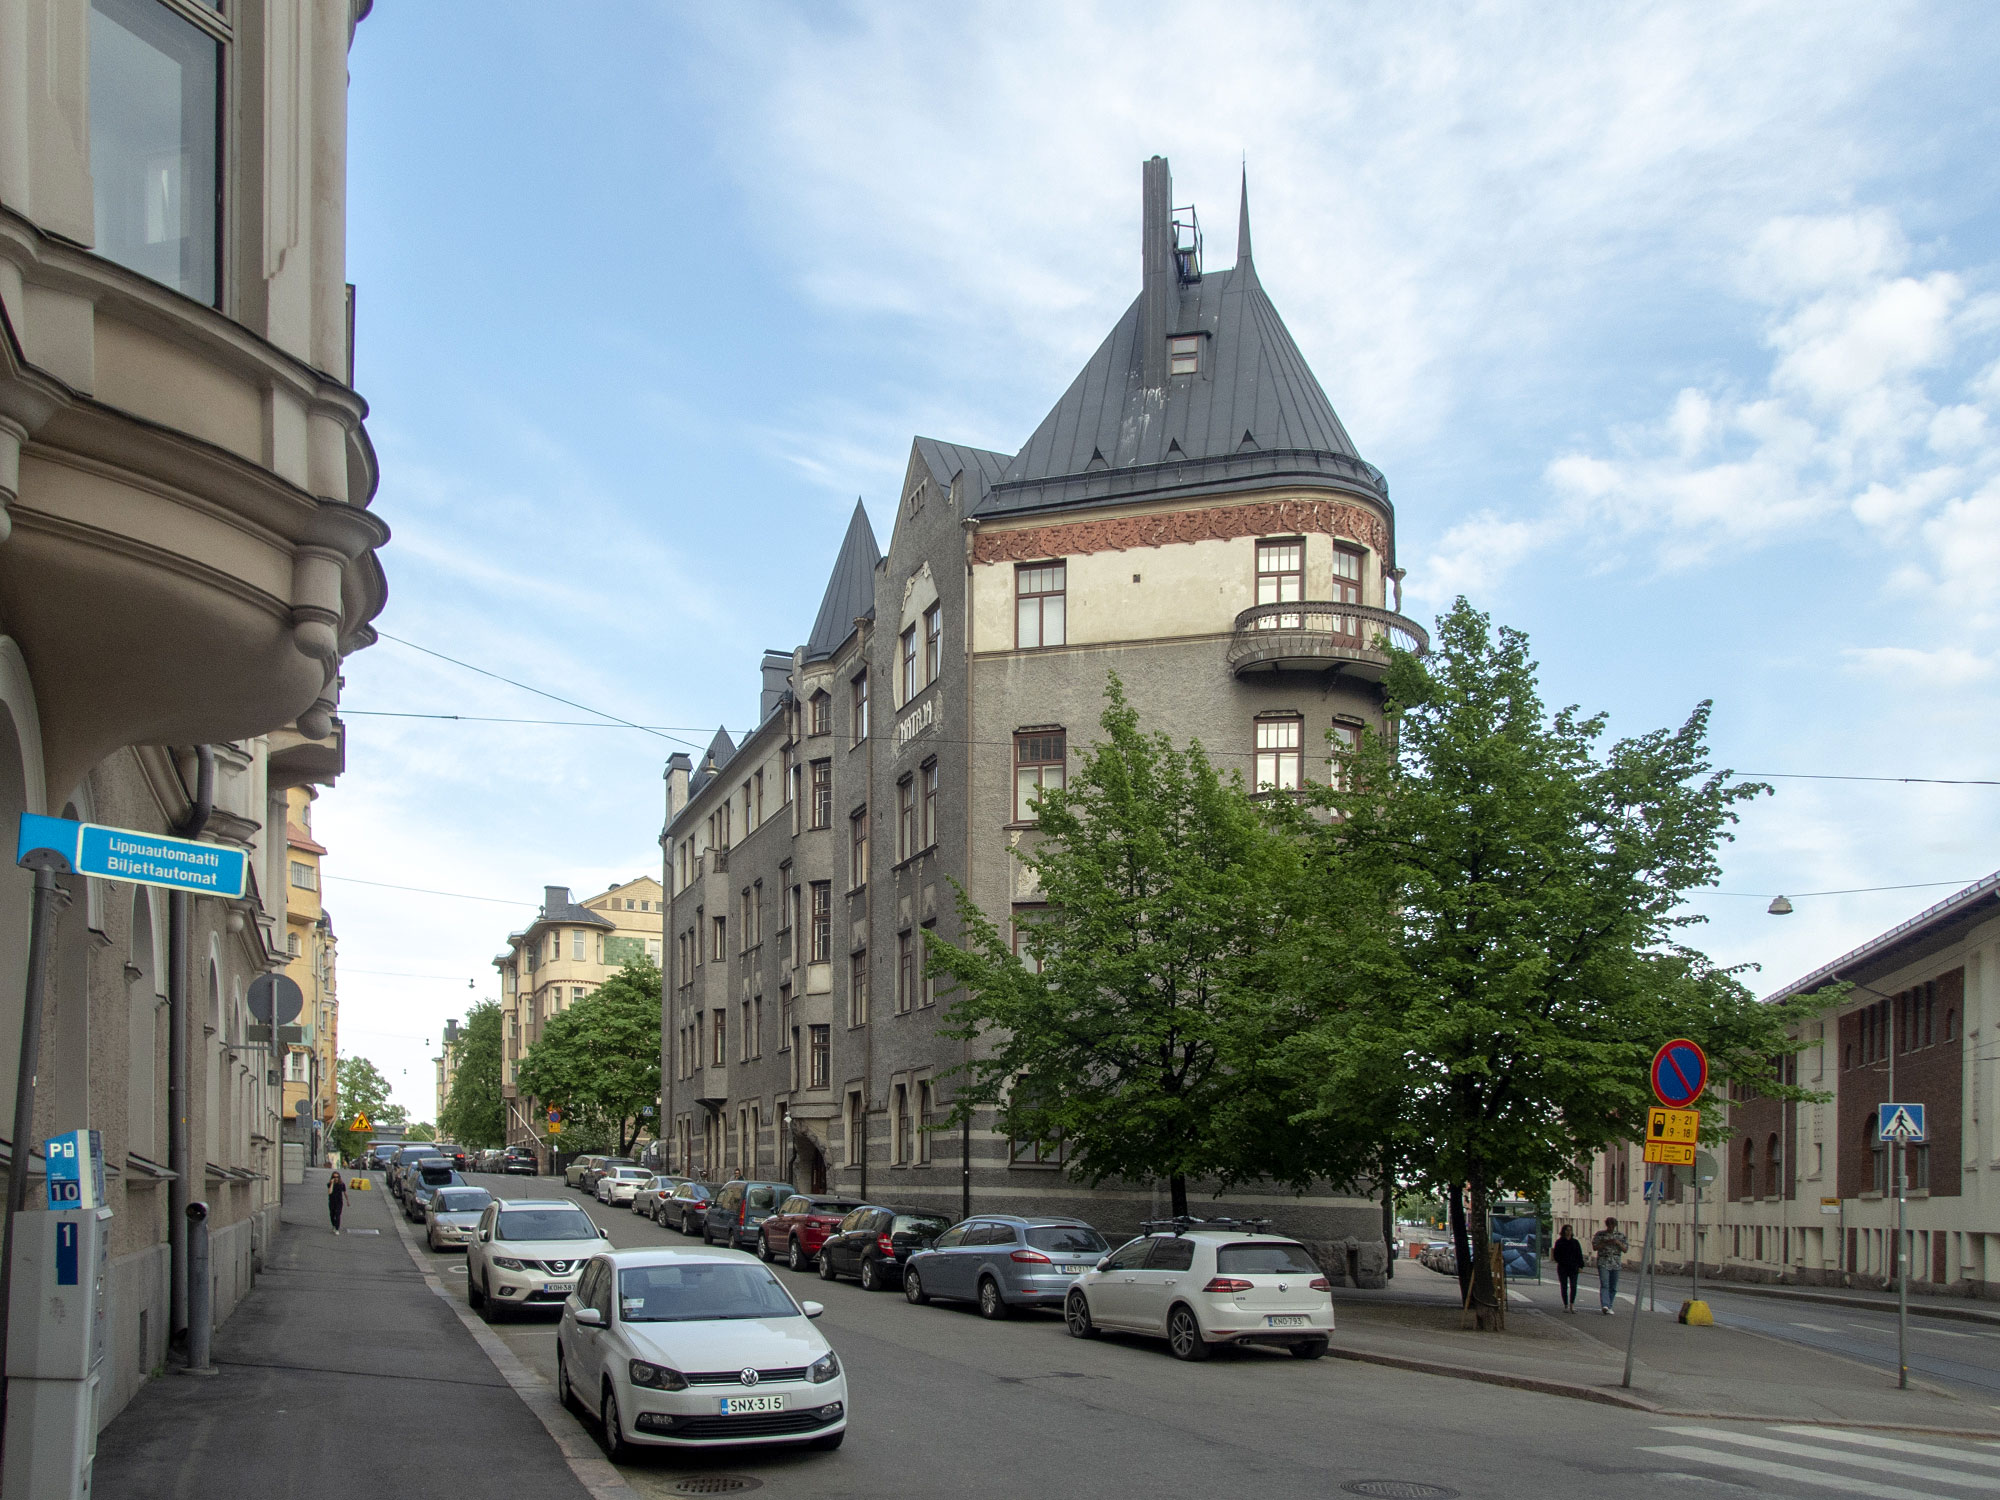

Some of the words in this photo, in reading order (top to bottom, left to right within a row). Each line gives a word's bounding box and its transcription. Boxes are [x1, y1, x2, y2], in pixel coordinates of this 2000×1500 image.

[899, 699, 933, 746] KATAJA
[108, 836, 220, 868] Lippuautomaatti
[107, 856, 218, 886] Biljettautomat
[1670, 1114, 1676, 1124] 9
[1684, 1115, 1693, 1125] 21
[50, 1143, 62, 1158] P
[1684, 1149, 1692, 1160] D
[52, 1183, 79, 1201] 10
[63, 1224, 71, 1247] 1
[730, 1397, 782, 1412] SNX-315
